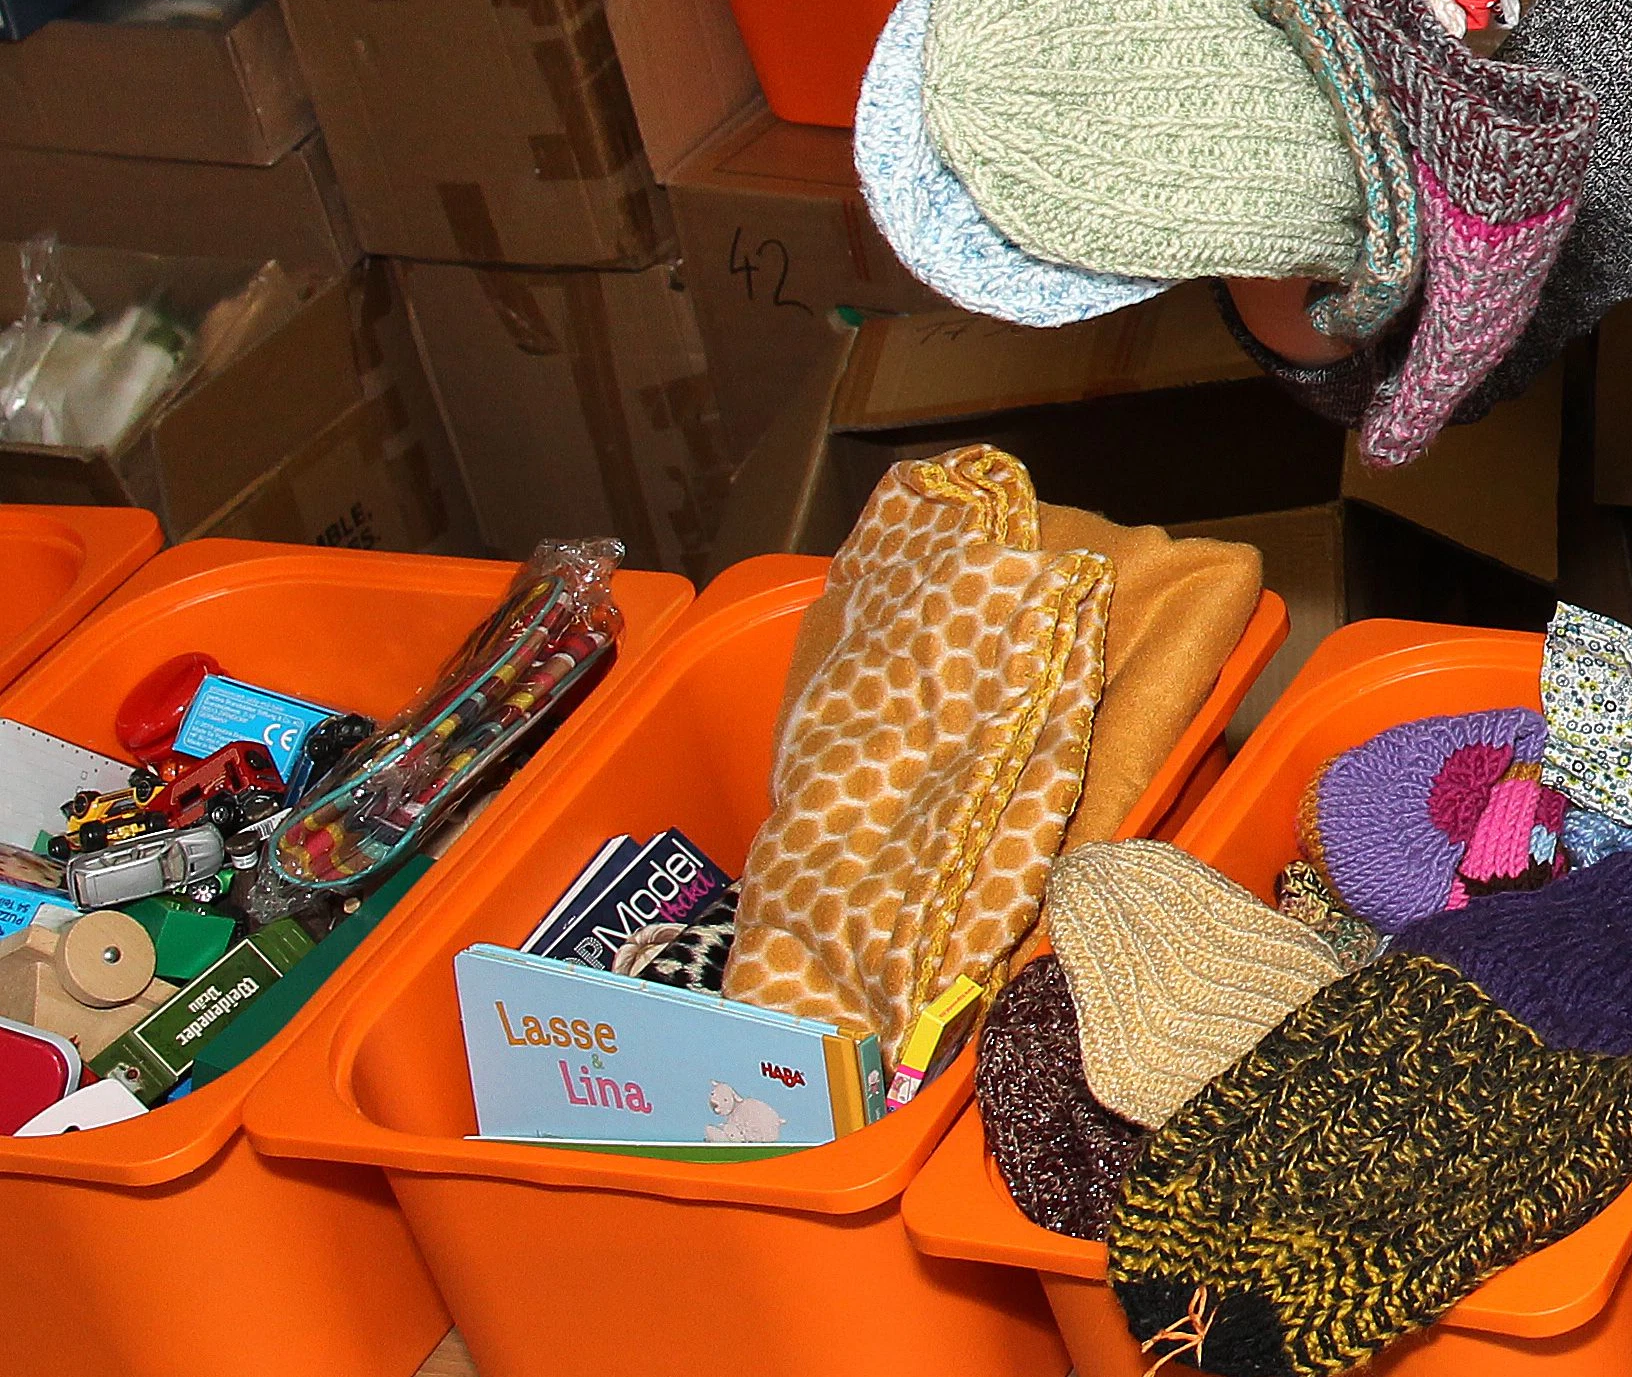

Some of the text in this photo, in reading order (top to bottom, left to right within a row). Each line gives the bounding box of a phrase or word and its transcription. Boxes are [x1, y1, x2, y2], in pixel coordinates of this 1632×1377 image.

[727, 225, 814, 315] 42
[591, 837, 704, 954] Model
[175, 977, 260, 1046] Weideneder
[494, 999, 620, 1055] Lasse
[557, 1058, 654, 1115] Lina
[591, 1053, 605, 1070] &
[760, 1060, 807, 1089] HABA
